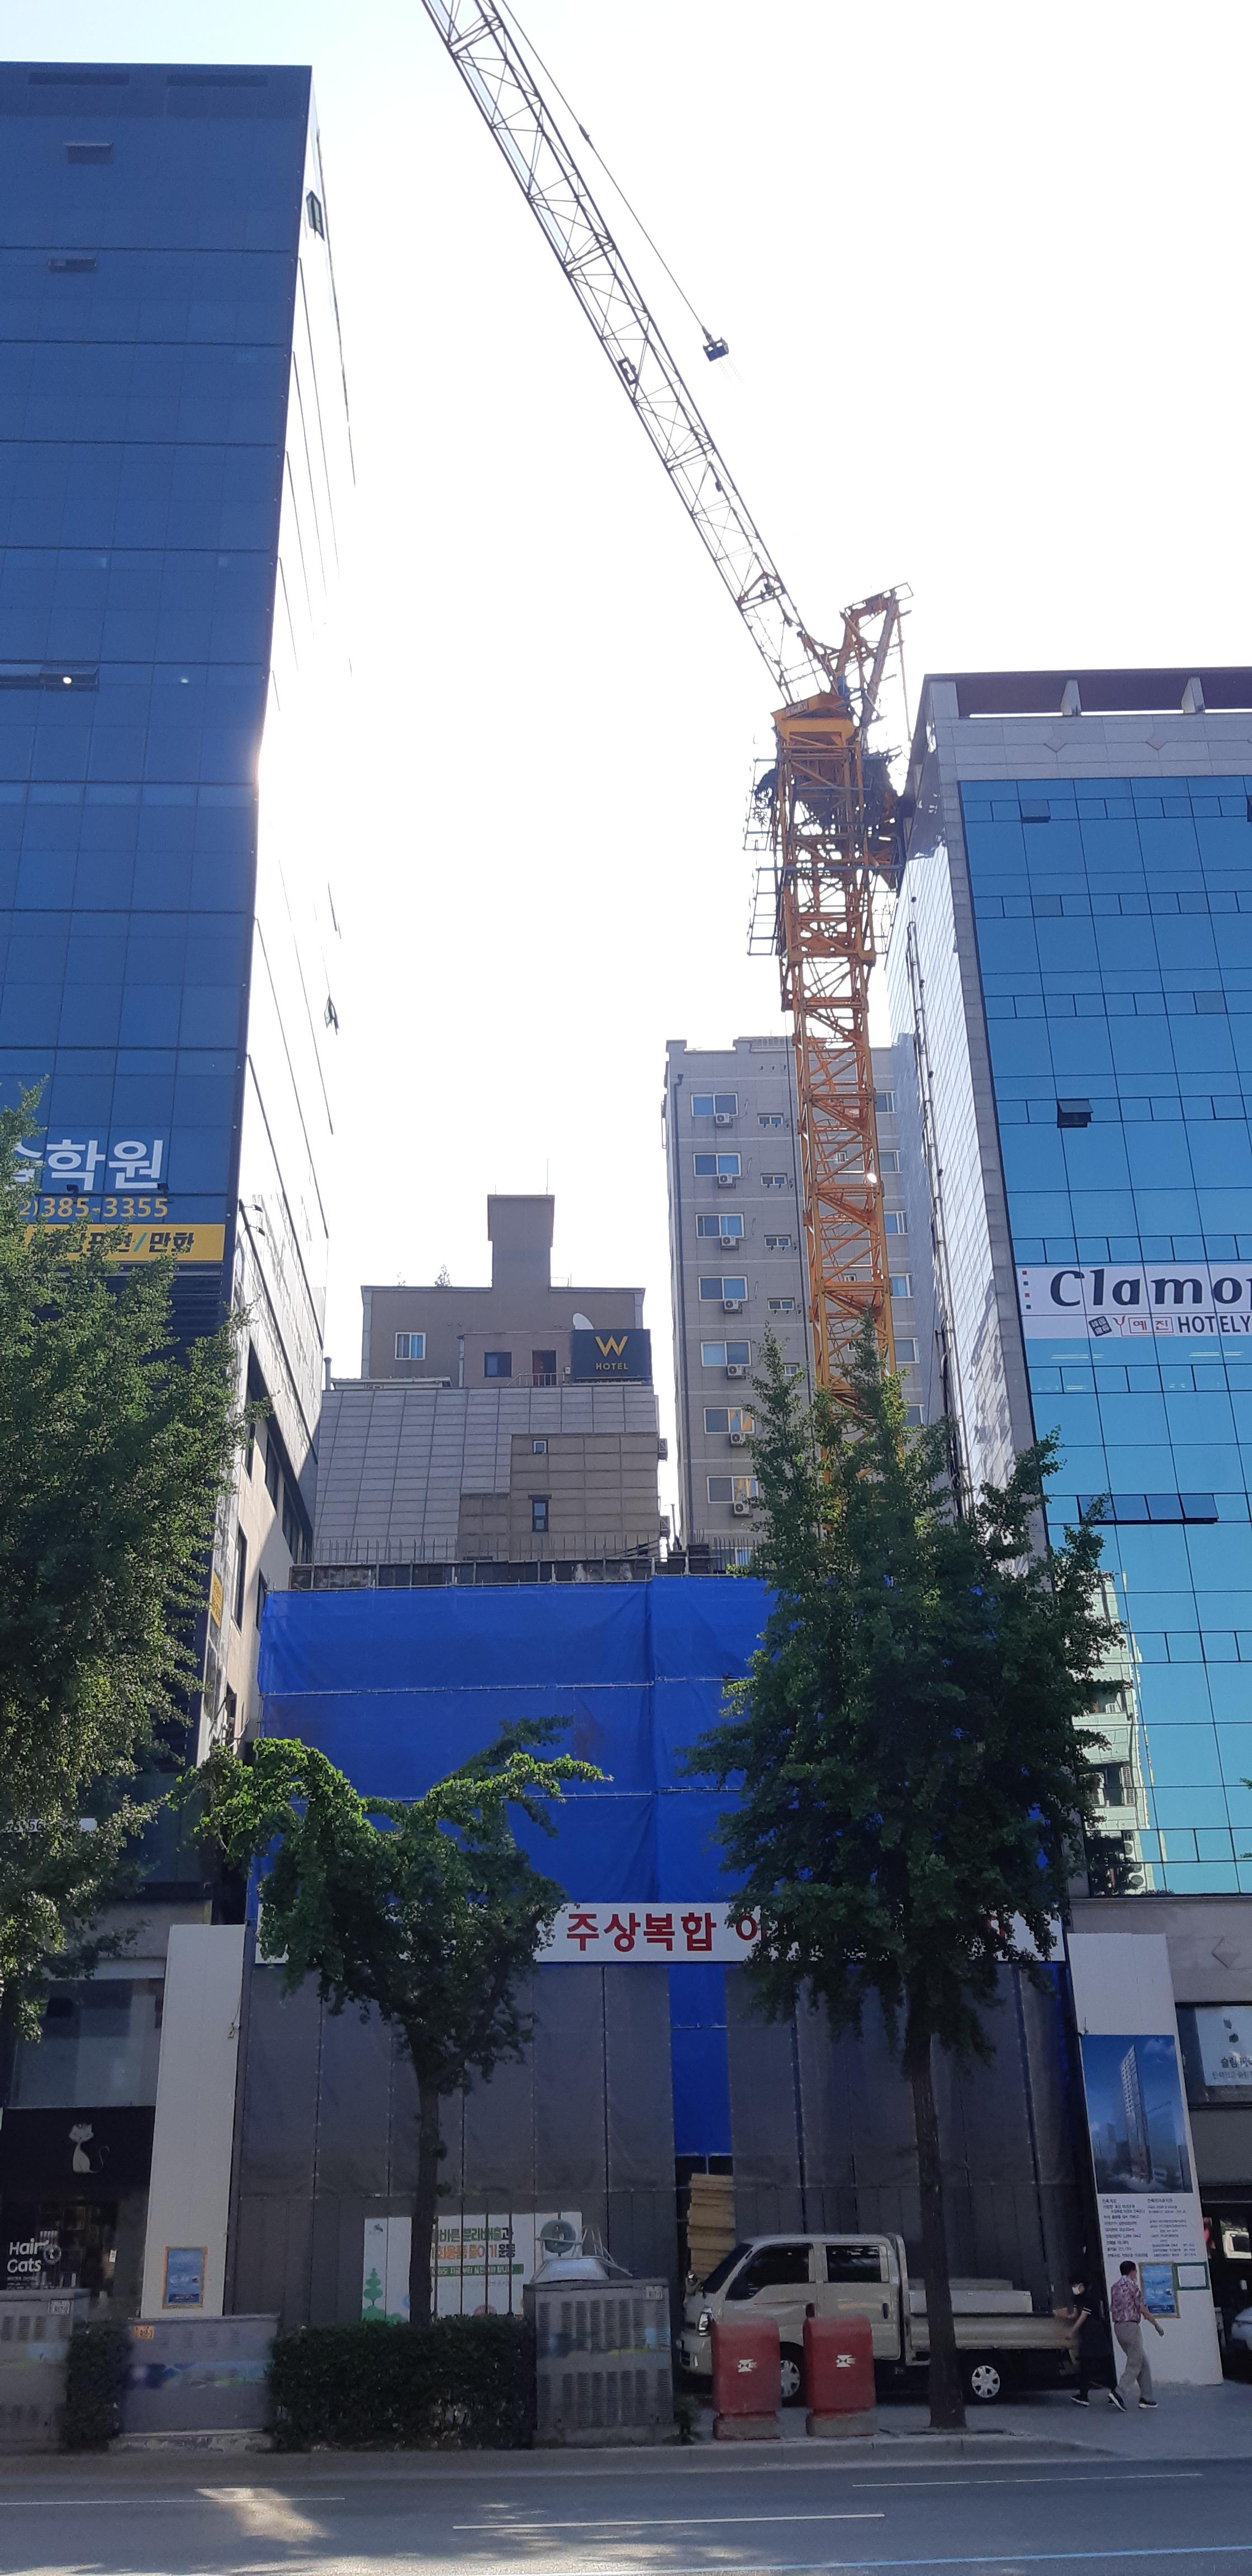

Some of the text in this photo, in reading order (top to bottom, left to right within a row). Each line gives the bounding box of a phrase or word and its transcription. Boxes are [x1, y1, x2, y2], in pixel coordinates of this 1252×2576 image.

[1133, 1320, 1169, 1331] 예진
[595, 1335, 628, 1357] W
[566, 1912, 717, 1953] 주상복합
[9, 2238, 50, 2256] Hair
[7, 2257, 42, 2274] Cats
